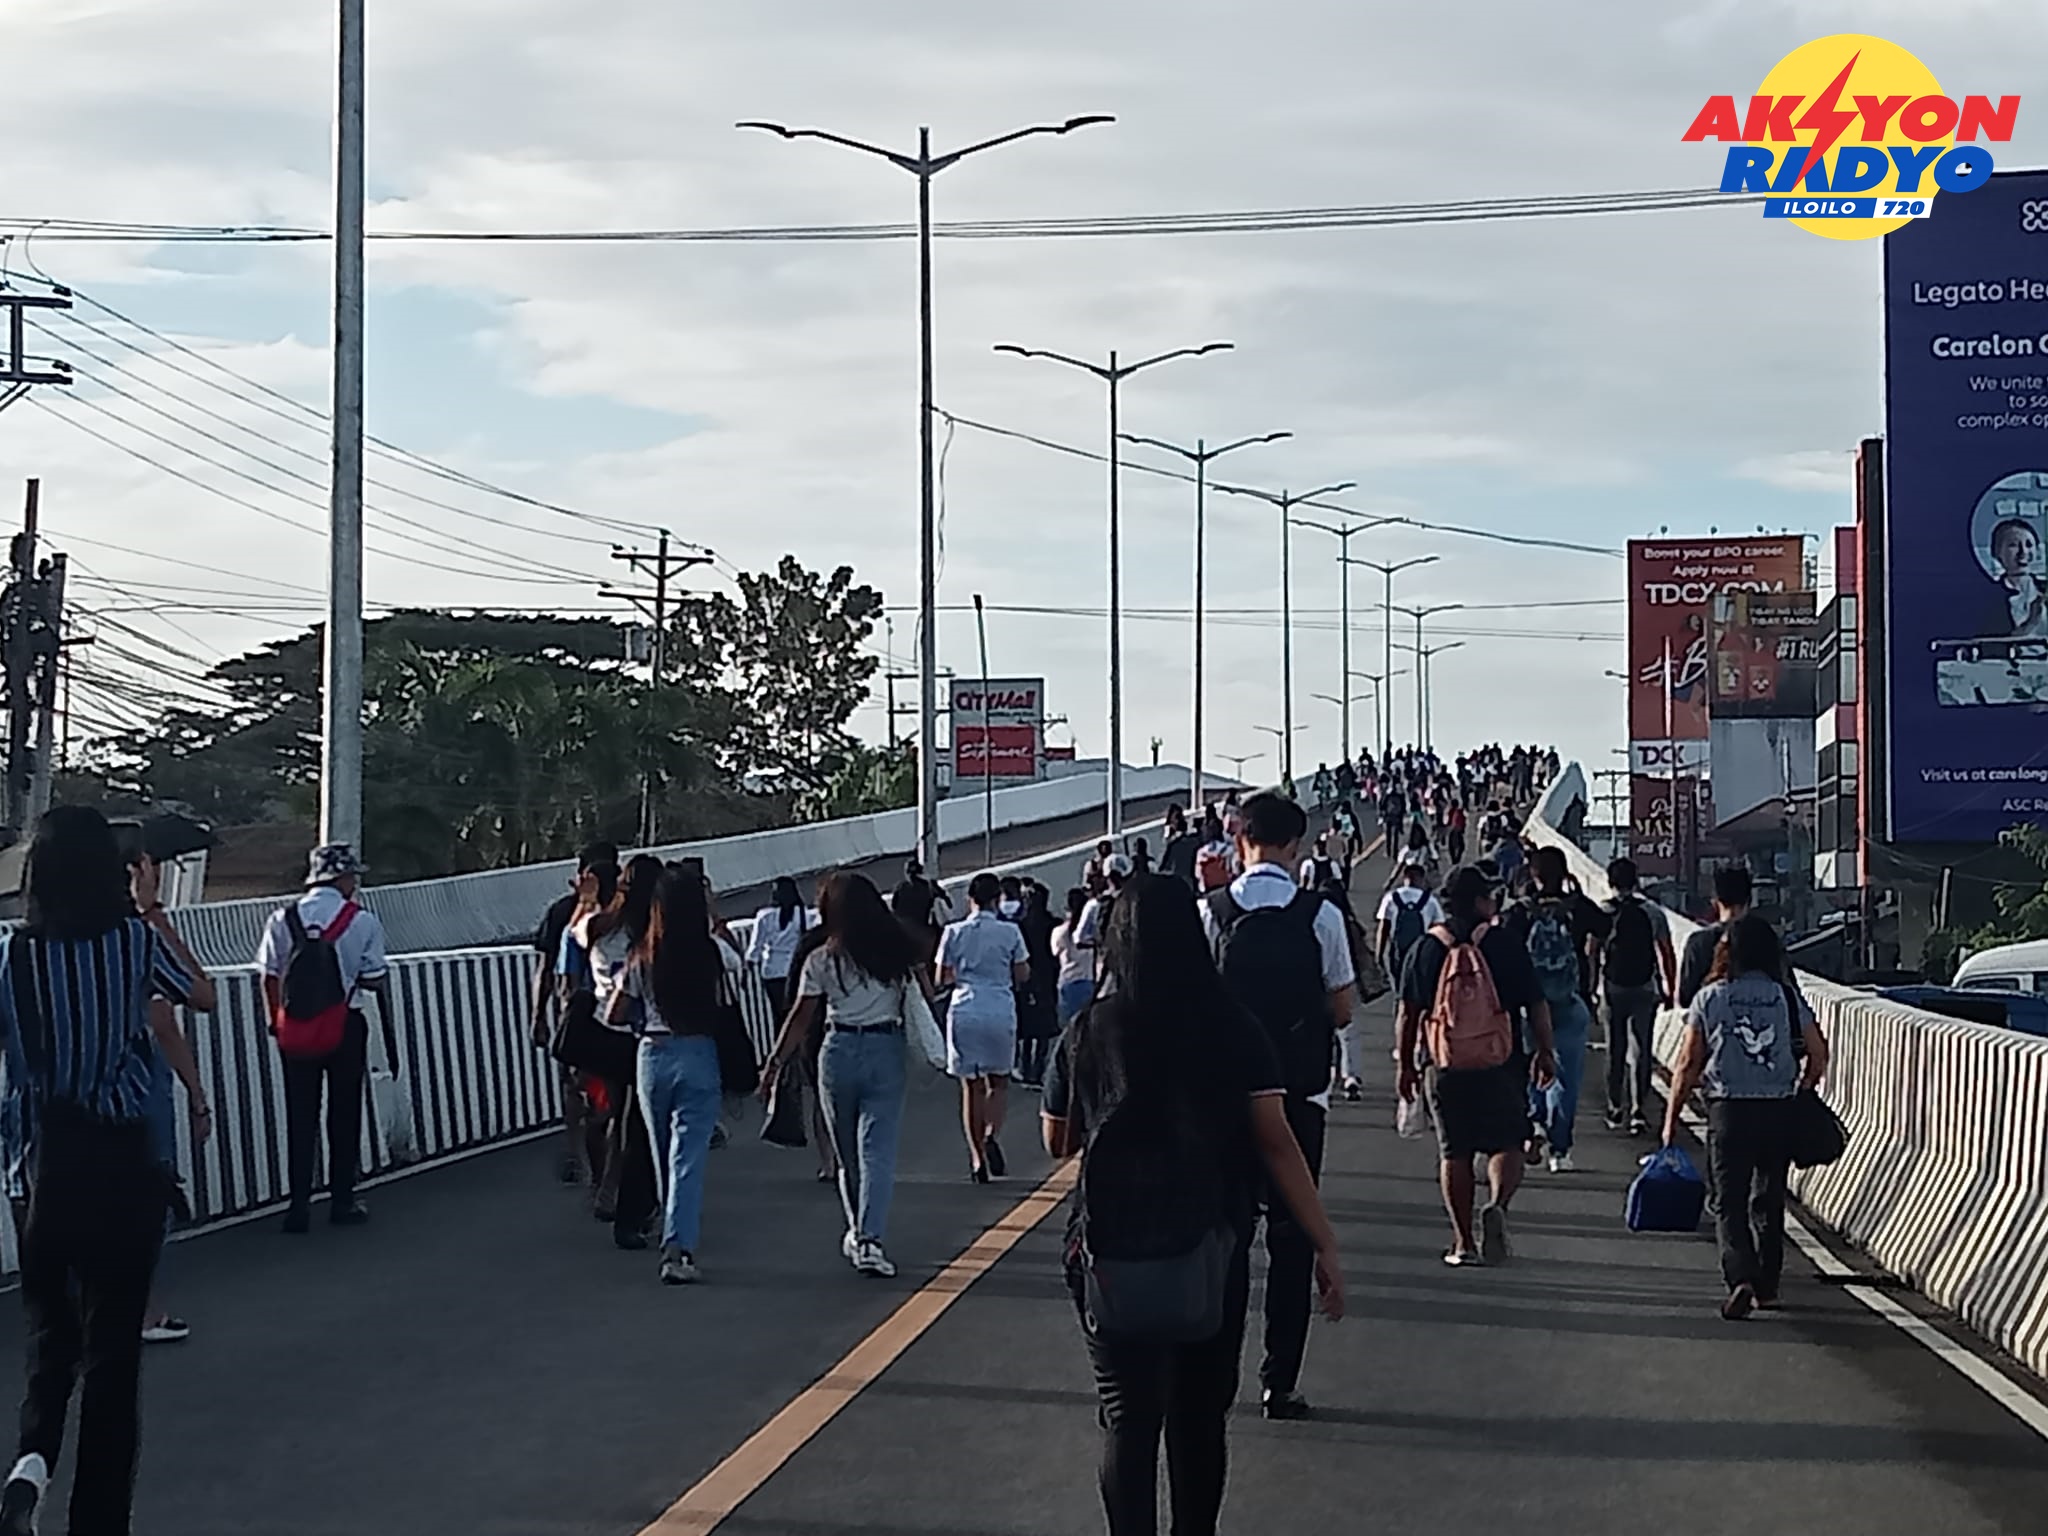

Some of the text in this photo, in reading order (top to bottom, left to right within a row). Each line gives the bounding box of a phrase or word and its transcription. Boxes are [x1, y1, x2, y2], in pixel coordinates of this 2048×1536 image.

[1913, 278, 2048, 308] Legato He
[1932, 332, 2033, 358] Carelon
[1968, 375, 2044, 391] We unite
[2009, 394, 2027, 409] to
[1957, 411, 2030, 430] complex
[1682, 548, 1711, 561] your
[1713, 545, 1743, 558] BPO
[1672, 564, 1709, 578] Apply
[1711, 565, 1739, 576] now
[1920, 768, 1951, 782] Visit
[1952, 770, 1969, 782] us
[1970, 768, 1986, 782] at
[2002, 797, 2032, 812] ASC
